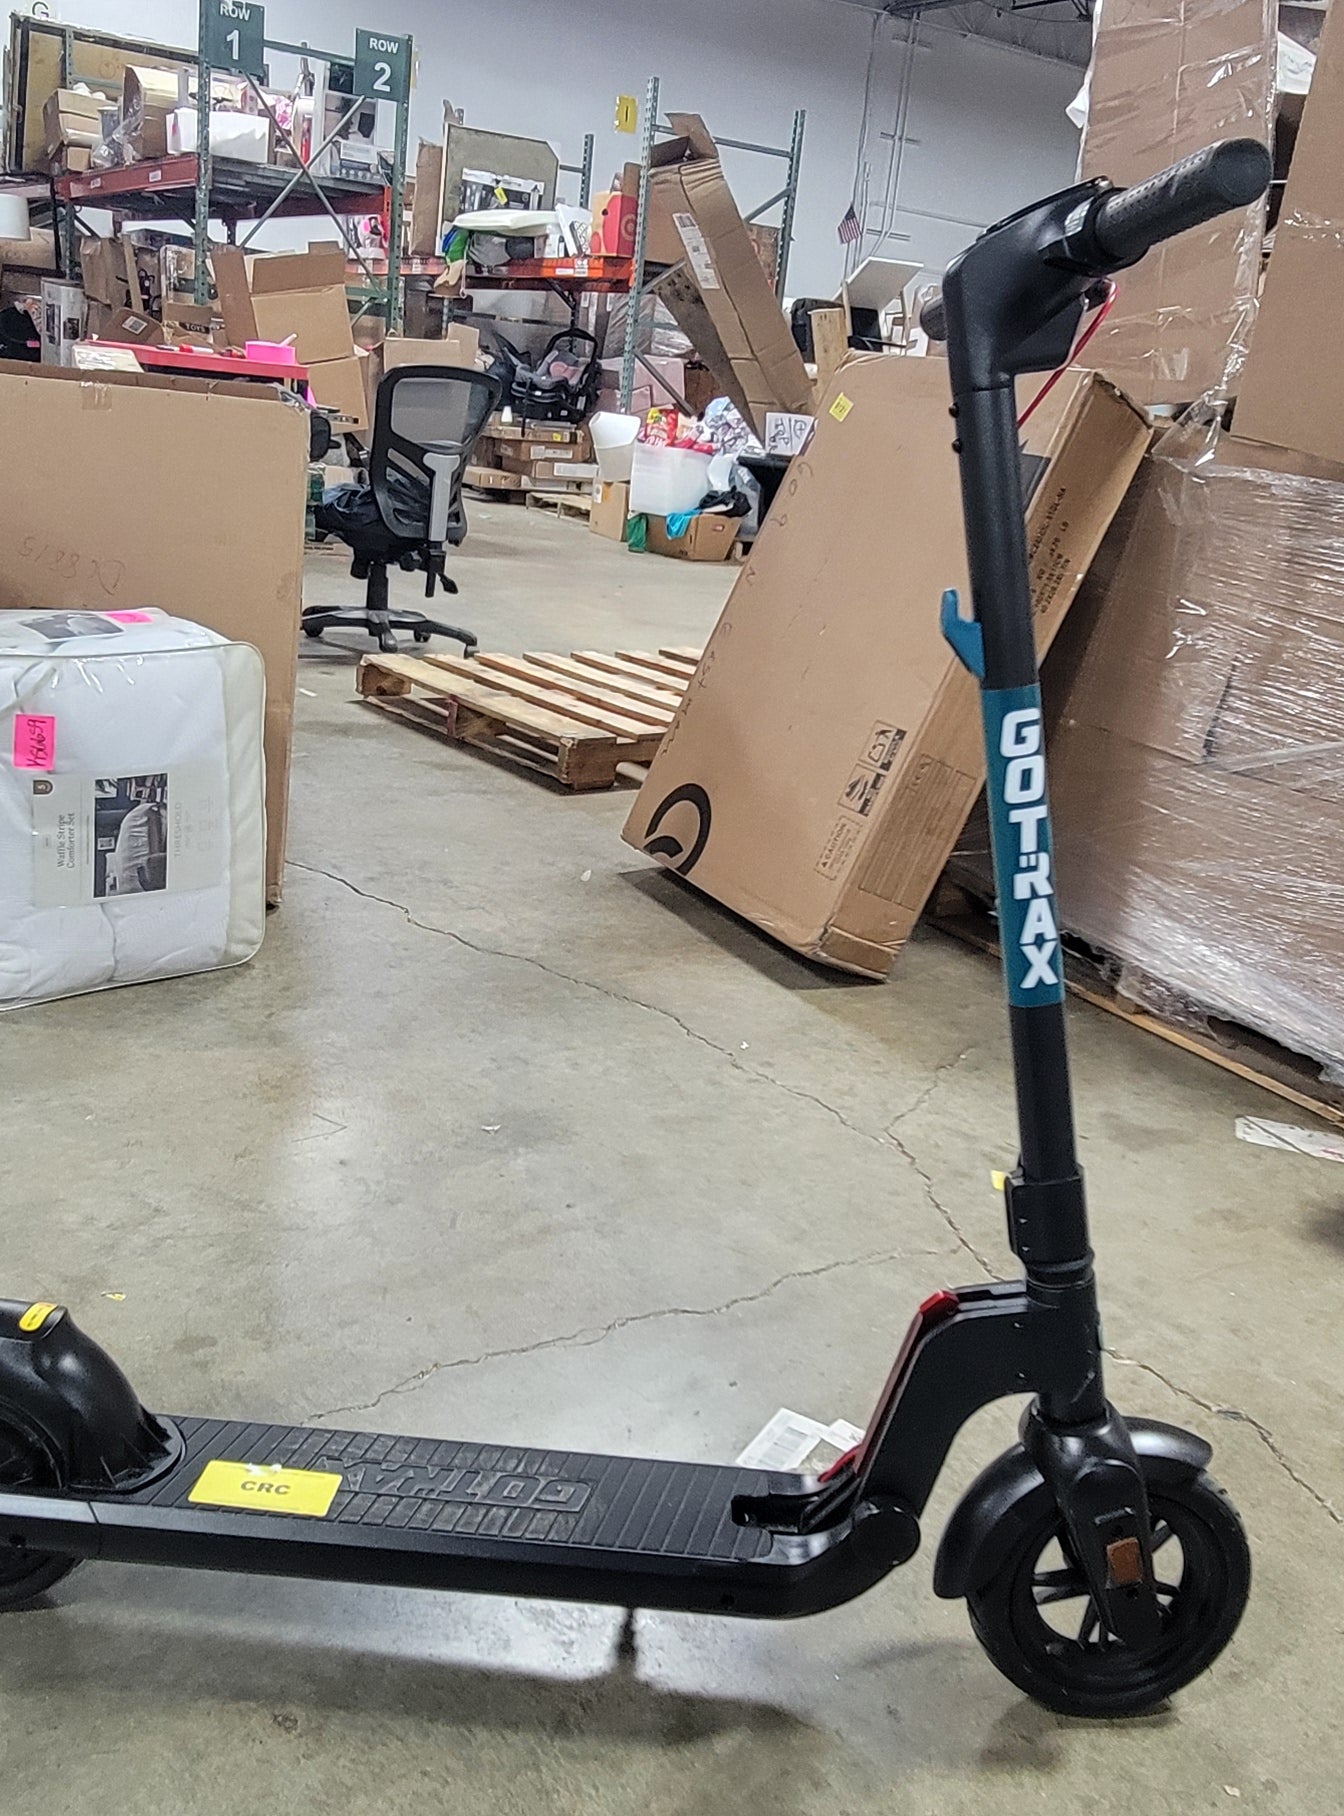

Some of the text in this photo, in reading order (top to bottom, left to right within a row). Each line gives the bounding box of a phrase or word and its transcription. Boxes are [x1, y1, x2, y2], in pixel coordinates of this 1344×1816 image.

[219, 4, 251, 21] ROW
[225, 29, 240, 61] 1
[369, 37, 399, 54] ROW
[372, 62, 392, 92] 2
[56, 814, 69, 868] Waffle Stripe
[66, 813, 76, 869] Comforter Set
[173, 802, 183, 857] THRESHOLD
[1000, 707, 1059, 989] GOTRAX
[240, 1479, 292, 1497] CRC
